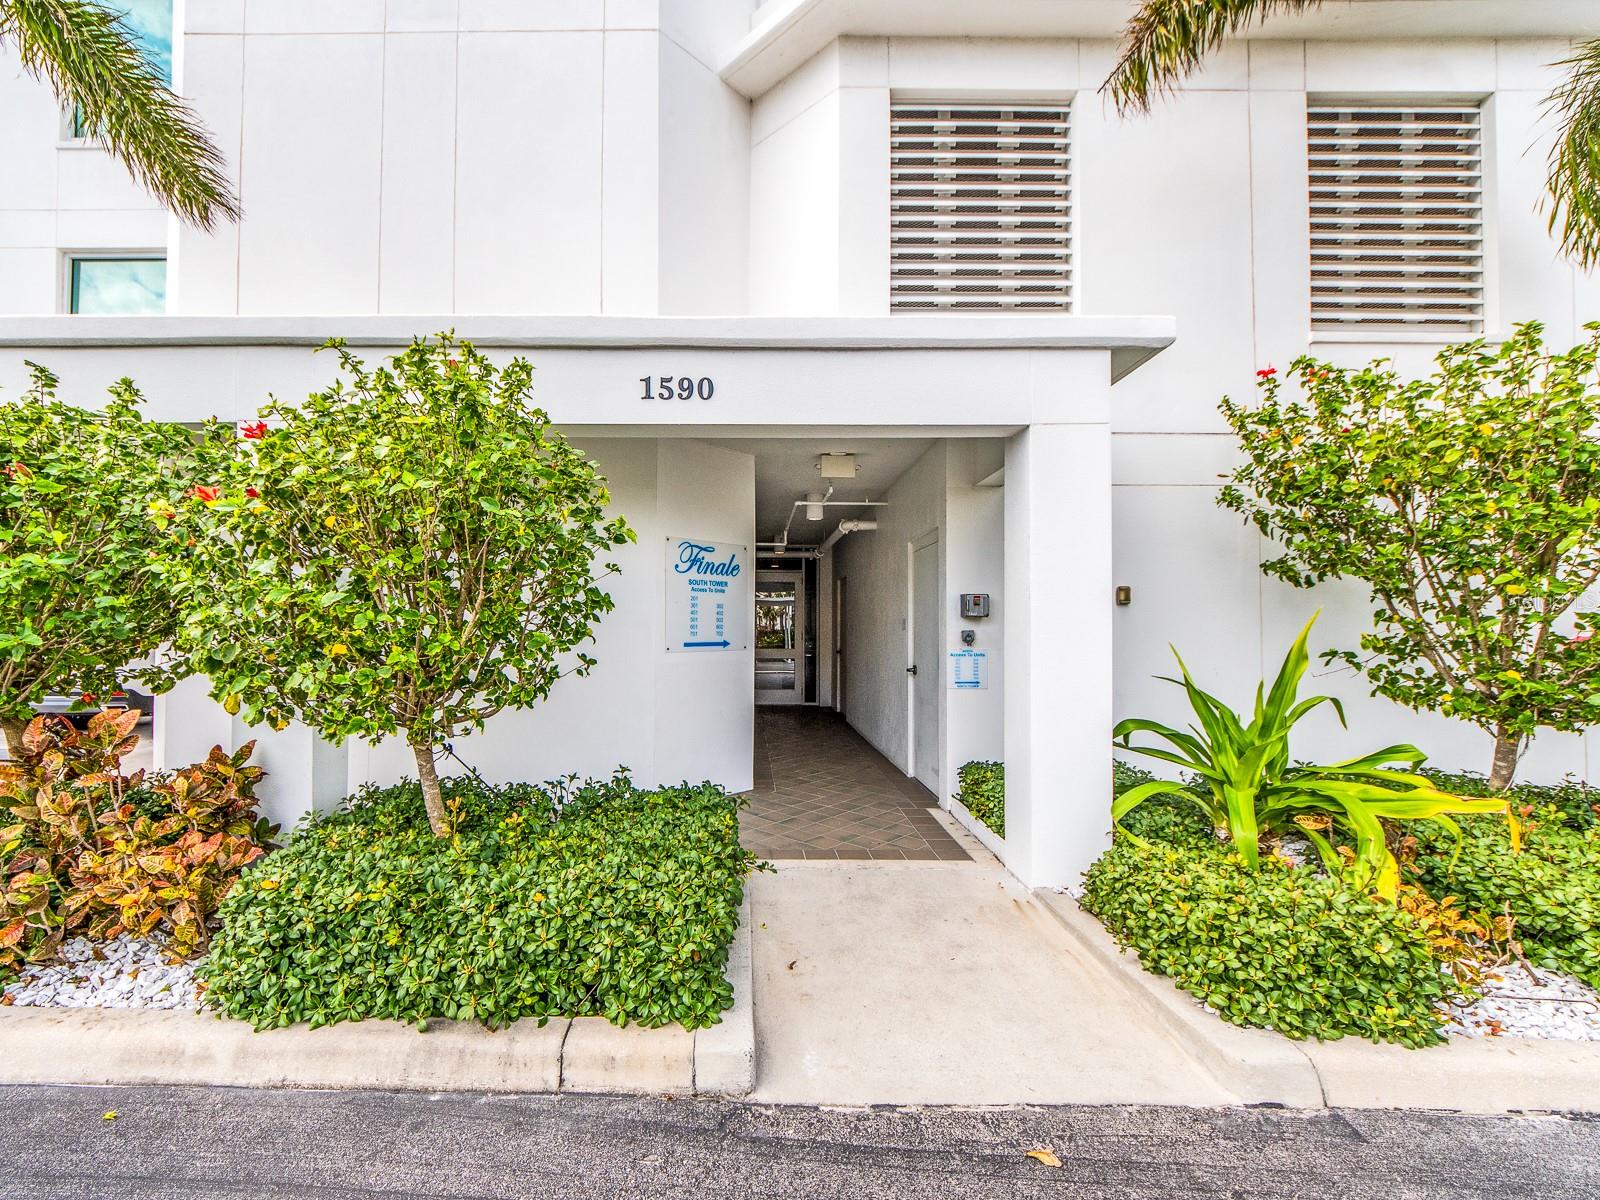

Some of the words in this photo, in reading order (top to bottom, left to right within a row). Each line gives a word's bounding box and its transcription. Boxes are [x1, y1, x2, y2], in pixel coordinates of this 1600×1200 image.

[640, 376, 714, 400] 1590
[674, 541, 741, 577] Finale
[688, 579, 708, 587] SOUTH
[709, 580, 729, 588] TOWER
